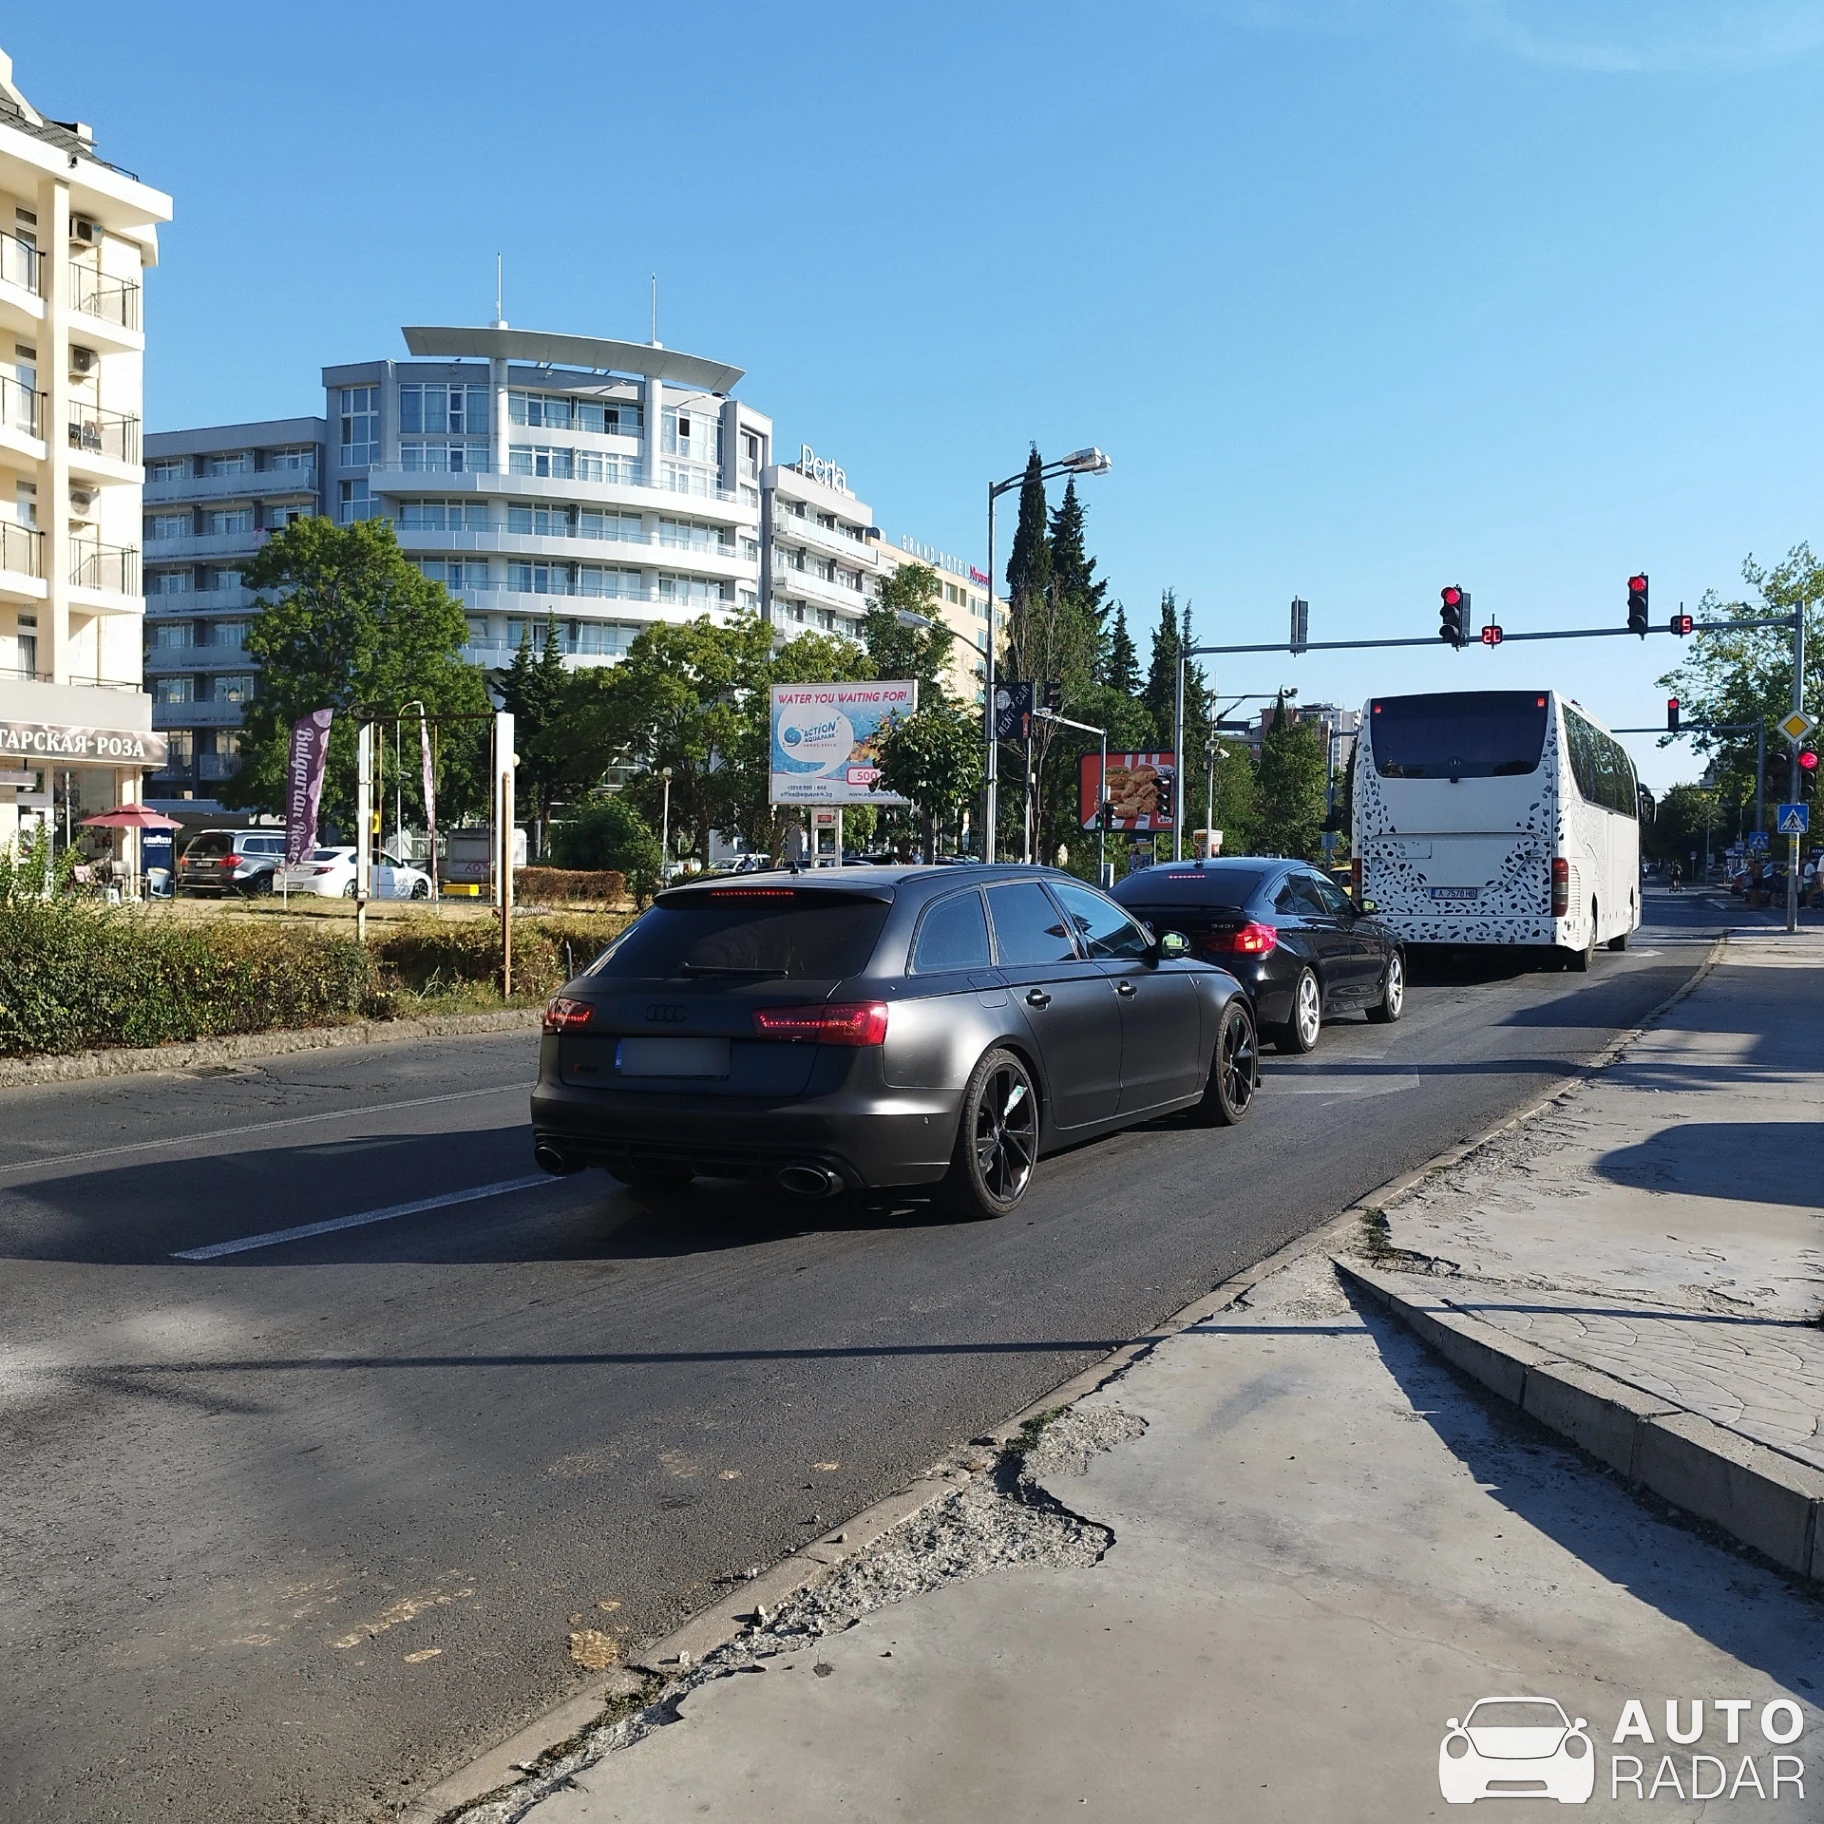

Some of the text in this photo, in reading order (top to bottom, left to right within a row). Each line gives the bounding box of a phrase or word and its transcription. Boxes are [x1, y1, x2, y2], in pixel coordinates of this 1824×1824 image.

[801, 443, 847, 495] Perla
[902, 533, 935, 563] GRAND
[939, 551, 970, 579] HOTEL
[778, 690, 907, 704] WATER YOU WAITING FOR!
[998, 709, 1016, 736] RENT
[1015, 684, 1030, 705] CAR
[96, 736, 146, 757] РОЗА
[804, 732, 836, 743] AQUAPARK
[290, 727, 315, 819] Bulgarian
